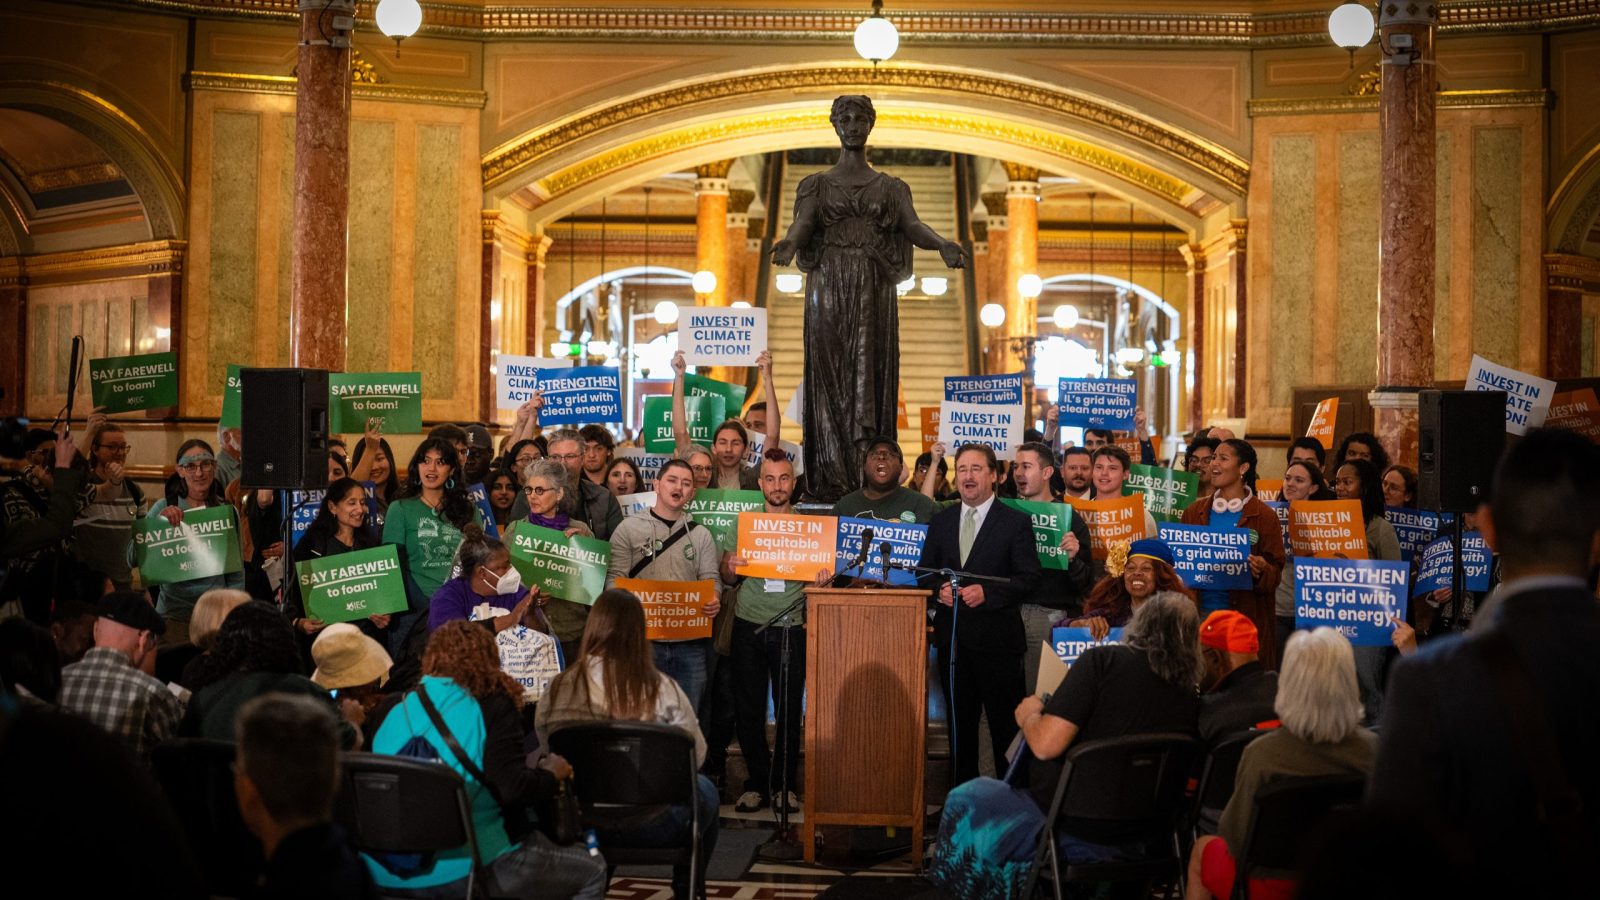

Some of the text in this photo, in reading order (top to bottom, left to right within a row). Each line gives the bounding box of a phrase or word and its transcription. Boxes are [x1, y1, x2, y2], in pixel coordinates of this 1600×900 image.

[691, 316, 754, 327] INVEST IN
[694, 330, 751, 341] CLIMATE
[694, 345, 750, 355] ACTION!
[92, 363, 175, 380] SAY FAREWELL
[506, 365, 538, 376] INVES
[112, 380, 156, 392] to foam!
[538, 376, 616, 390] STRENGTHEN
[946, 378, 1020, 390] STRENGTHEN
[1060, 381, 1135, 393] STRENGTHEN
[1478, 368, 1540, 398] INVEST IN
[332, 384, 419, 395] SAY FAREWELL
[508, 392, 532, 401] ACTI
[565, 394, 588, 406] grid
[590, 392, 613, 402] with
[971, 393, 992, 404] grid
[995, 392, 1016, 400] with
[1064, 395, 1130, 406] IL's grid with
[353, 400, 398, 410] to foam!
[542, 404, 618, 416] clean energy!
[1575, 402, 1588, 413] IN
[951, 411, 994, 423] INVEST
[998, 414, 1011, 424] IN
[1060, 406, 1134, 418] clean energy!
[692, 427, 708, 437] IT!
[953, 425, 1008, 438] CLIMATE
[1128, 474, 1187, 492] UPGRADE
[1258, 490, 1280, 500] INV
[683, 501, 706, 510] SAY
[1120, 507, 1133, 520] IN
[1294, 512, 1334, 523] INVEST
[1337, 512, 1351, 523] IN
[753, 519, 822, 534] INVEST IN
[1089, 524, 1132, 536] uitable
[136, 529, 162, 544] SAY
[1036, 532, 1047, 541] to
[1160, 528, 1247, 545] STRENGTHEN
[1298, 528, 1351, 540] equitable
[1408, 530, 1431, 541] grid
[755, 535, 819, 550] equitable
[842, 538, 862, 549] IL's
[894, 544, 920, 556] with
[1292, 539, 1364, 550] transit for all!
[162, 548, 173, 557] to
[515, 534, 607, 565] SAY FAREWELL
[1186, 548, 1211, 561] grid
[1214, 549, 1242, 560] with
[741, 549, 830, 563] transit for all!
[301, 558, 398, 585] SAY FAREWELL
[533, 557, 582, 576] to foam!
[783, 565, 796, 573] IEC
[1197, 562, 1248, 575] energy!
[1296, 565, 1406, 585] STRENGTHEN
[1417, 567, 1438, 582] clean
[326, 580, 378, 598] to foam!
[552, 579, 564, 588] IEC
[685, 592, 700, 602] IN
[1301, 587, 1396, 607] IL's grid with
[666, 615, 685, 628] for
[688, 613, 708, 627] all!
[1298, 604, 1401, 627] clean energy!
[1344, 626, 1358, 636] IEC
